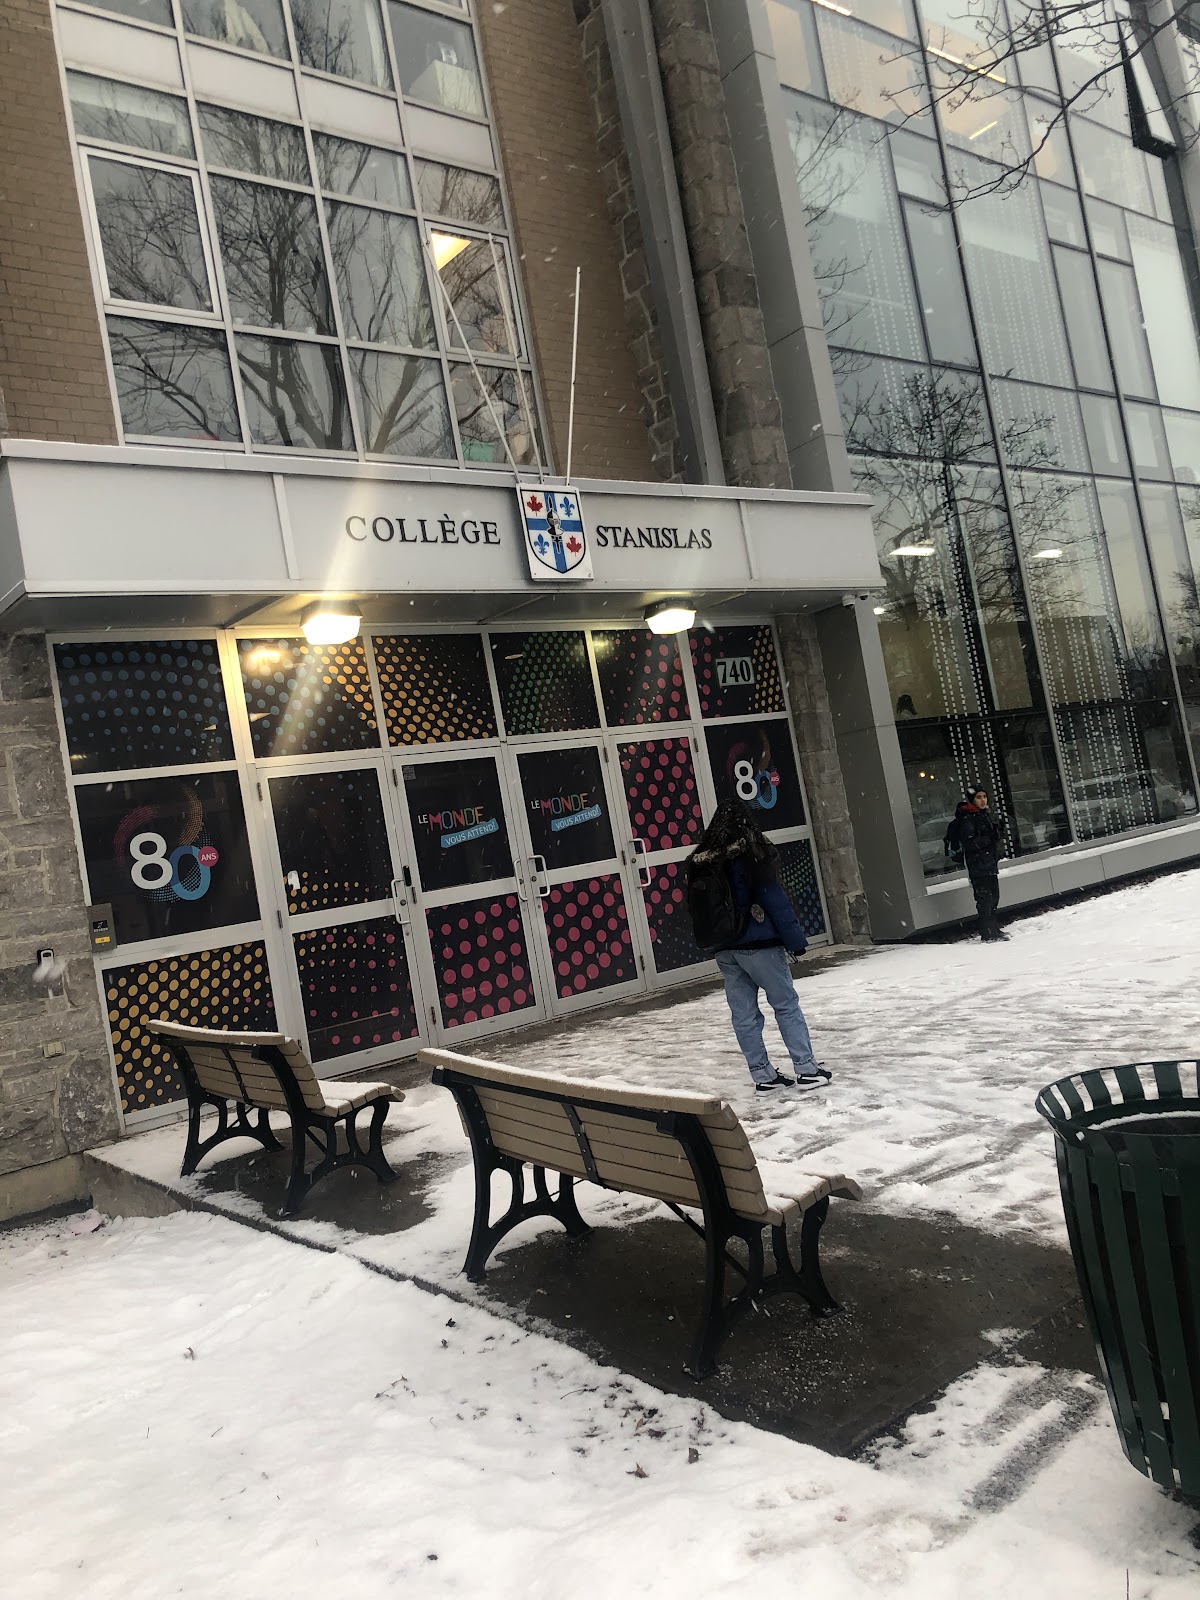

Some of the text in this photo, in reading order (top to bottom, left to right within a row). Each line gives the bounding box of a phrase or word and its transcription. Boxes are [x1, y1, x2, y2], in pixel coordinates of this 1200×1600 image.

[345, 513, 713, 549] COLLÈGE STANISLAS
[716, 659, 751, 684] 740
[734, 760, 778, 809] 80
[530, 792, 590, 816] LE MONDE
[418, 805, 486, 832] LE MONDE
[555, 808, 600, 830] VOUS ATTEND!
[445, 822, 496, 846] VOUS ATTEND!
[129, 832, 217, 901] 80 ANS
